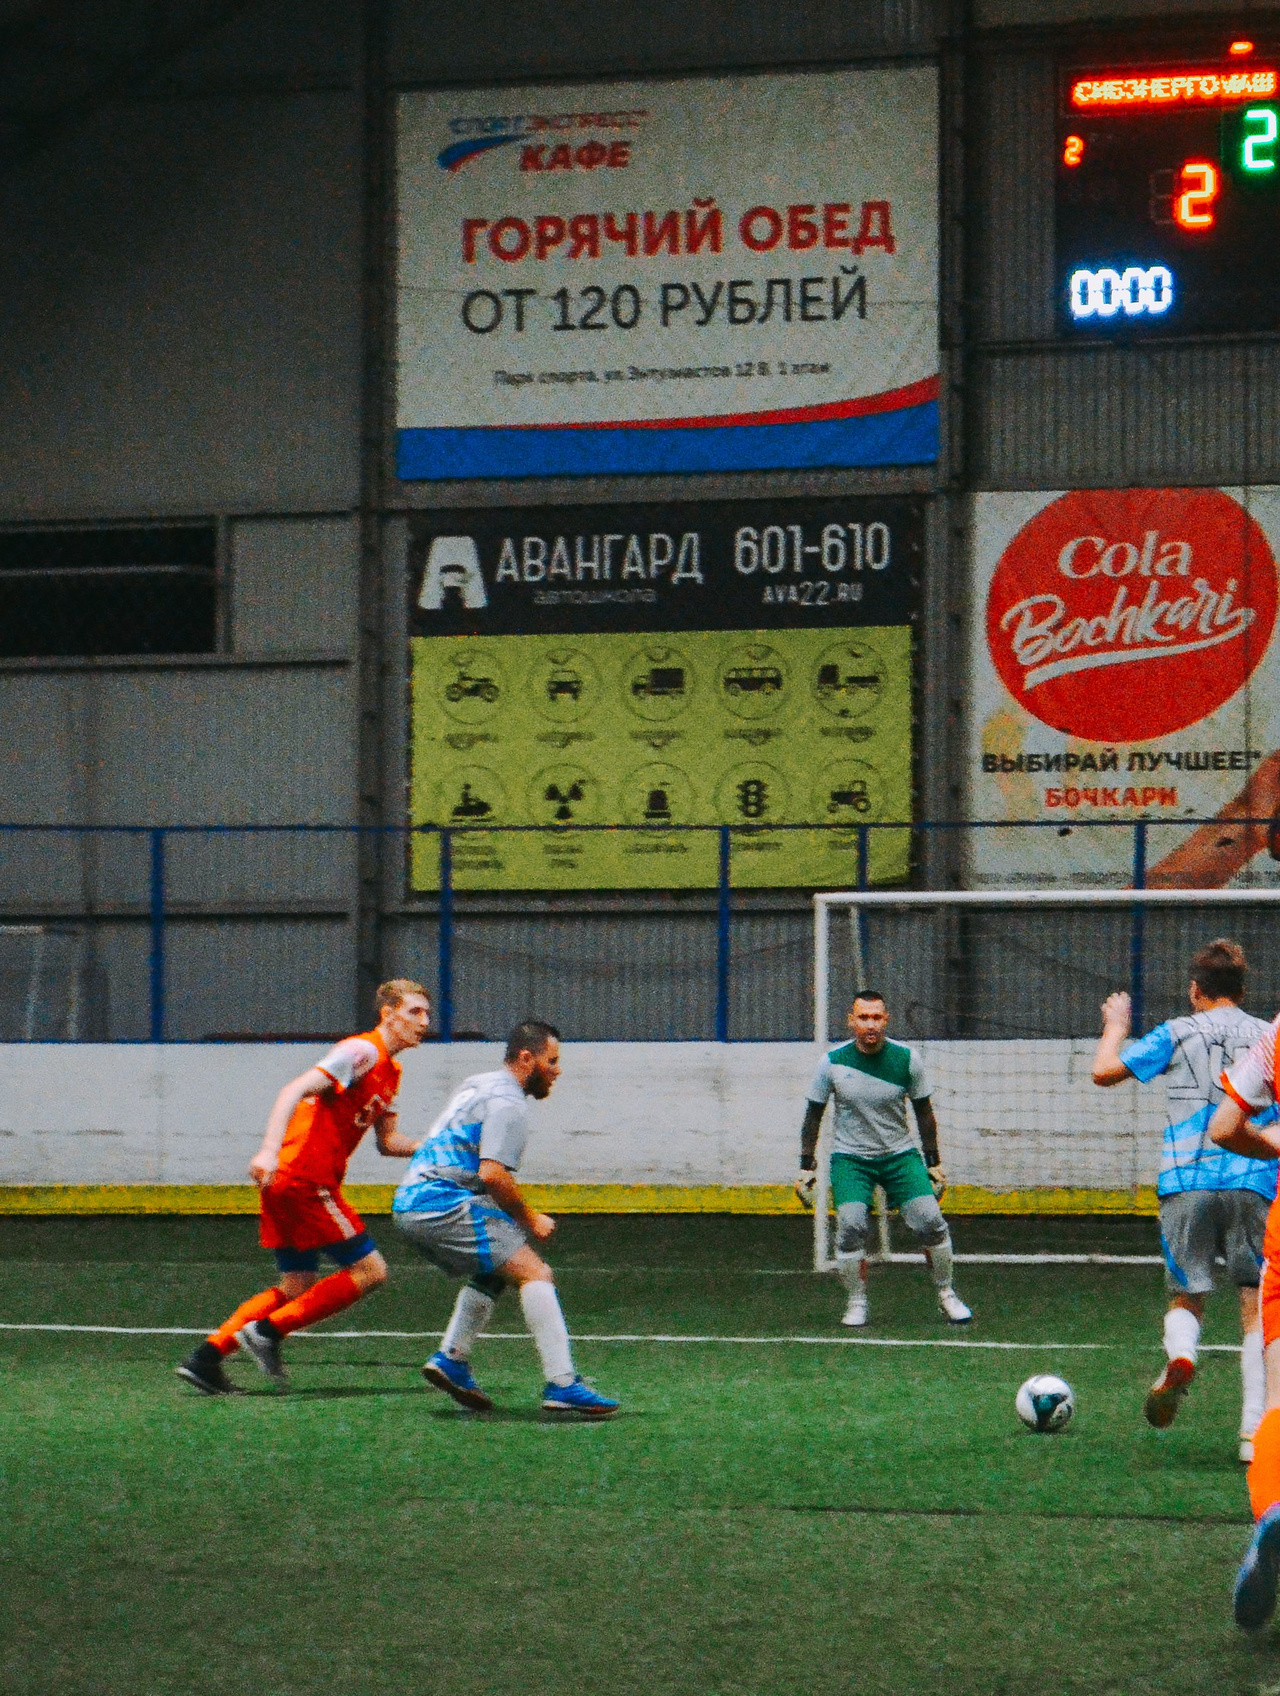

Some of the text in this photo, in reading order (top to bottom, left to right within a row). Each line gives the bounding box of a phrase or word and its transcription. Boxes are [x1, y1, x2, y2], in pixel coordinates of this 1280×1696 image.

[520, 140, 631, 172] КАФЕ
[1064, 135, 1084, 166] 2
[1243, 108, 1278, 170] 2
[1176, 160, 1219, 226] 2
[461, 197, 896, 263] ГОРЯЧИЙ ОБЕД
[460, 266, 868, 335] ОТ 120 РУБЛЕЙ
[495, 532, 706, 586] АВАНГАРД
[732, 521, 892, 575] 601-610
[1057, 529, 1195, 580] Cola
[1001, 577, 1257, 668] Bochkari
[981, 747, 1119, 773] ВЫБИРАЙ
[1044, 786, 1179, 808] БОЧКАРИ
